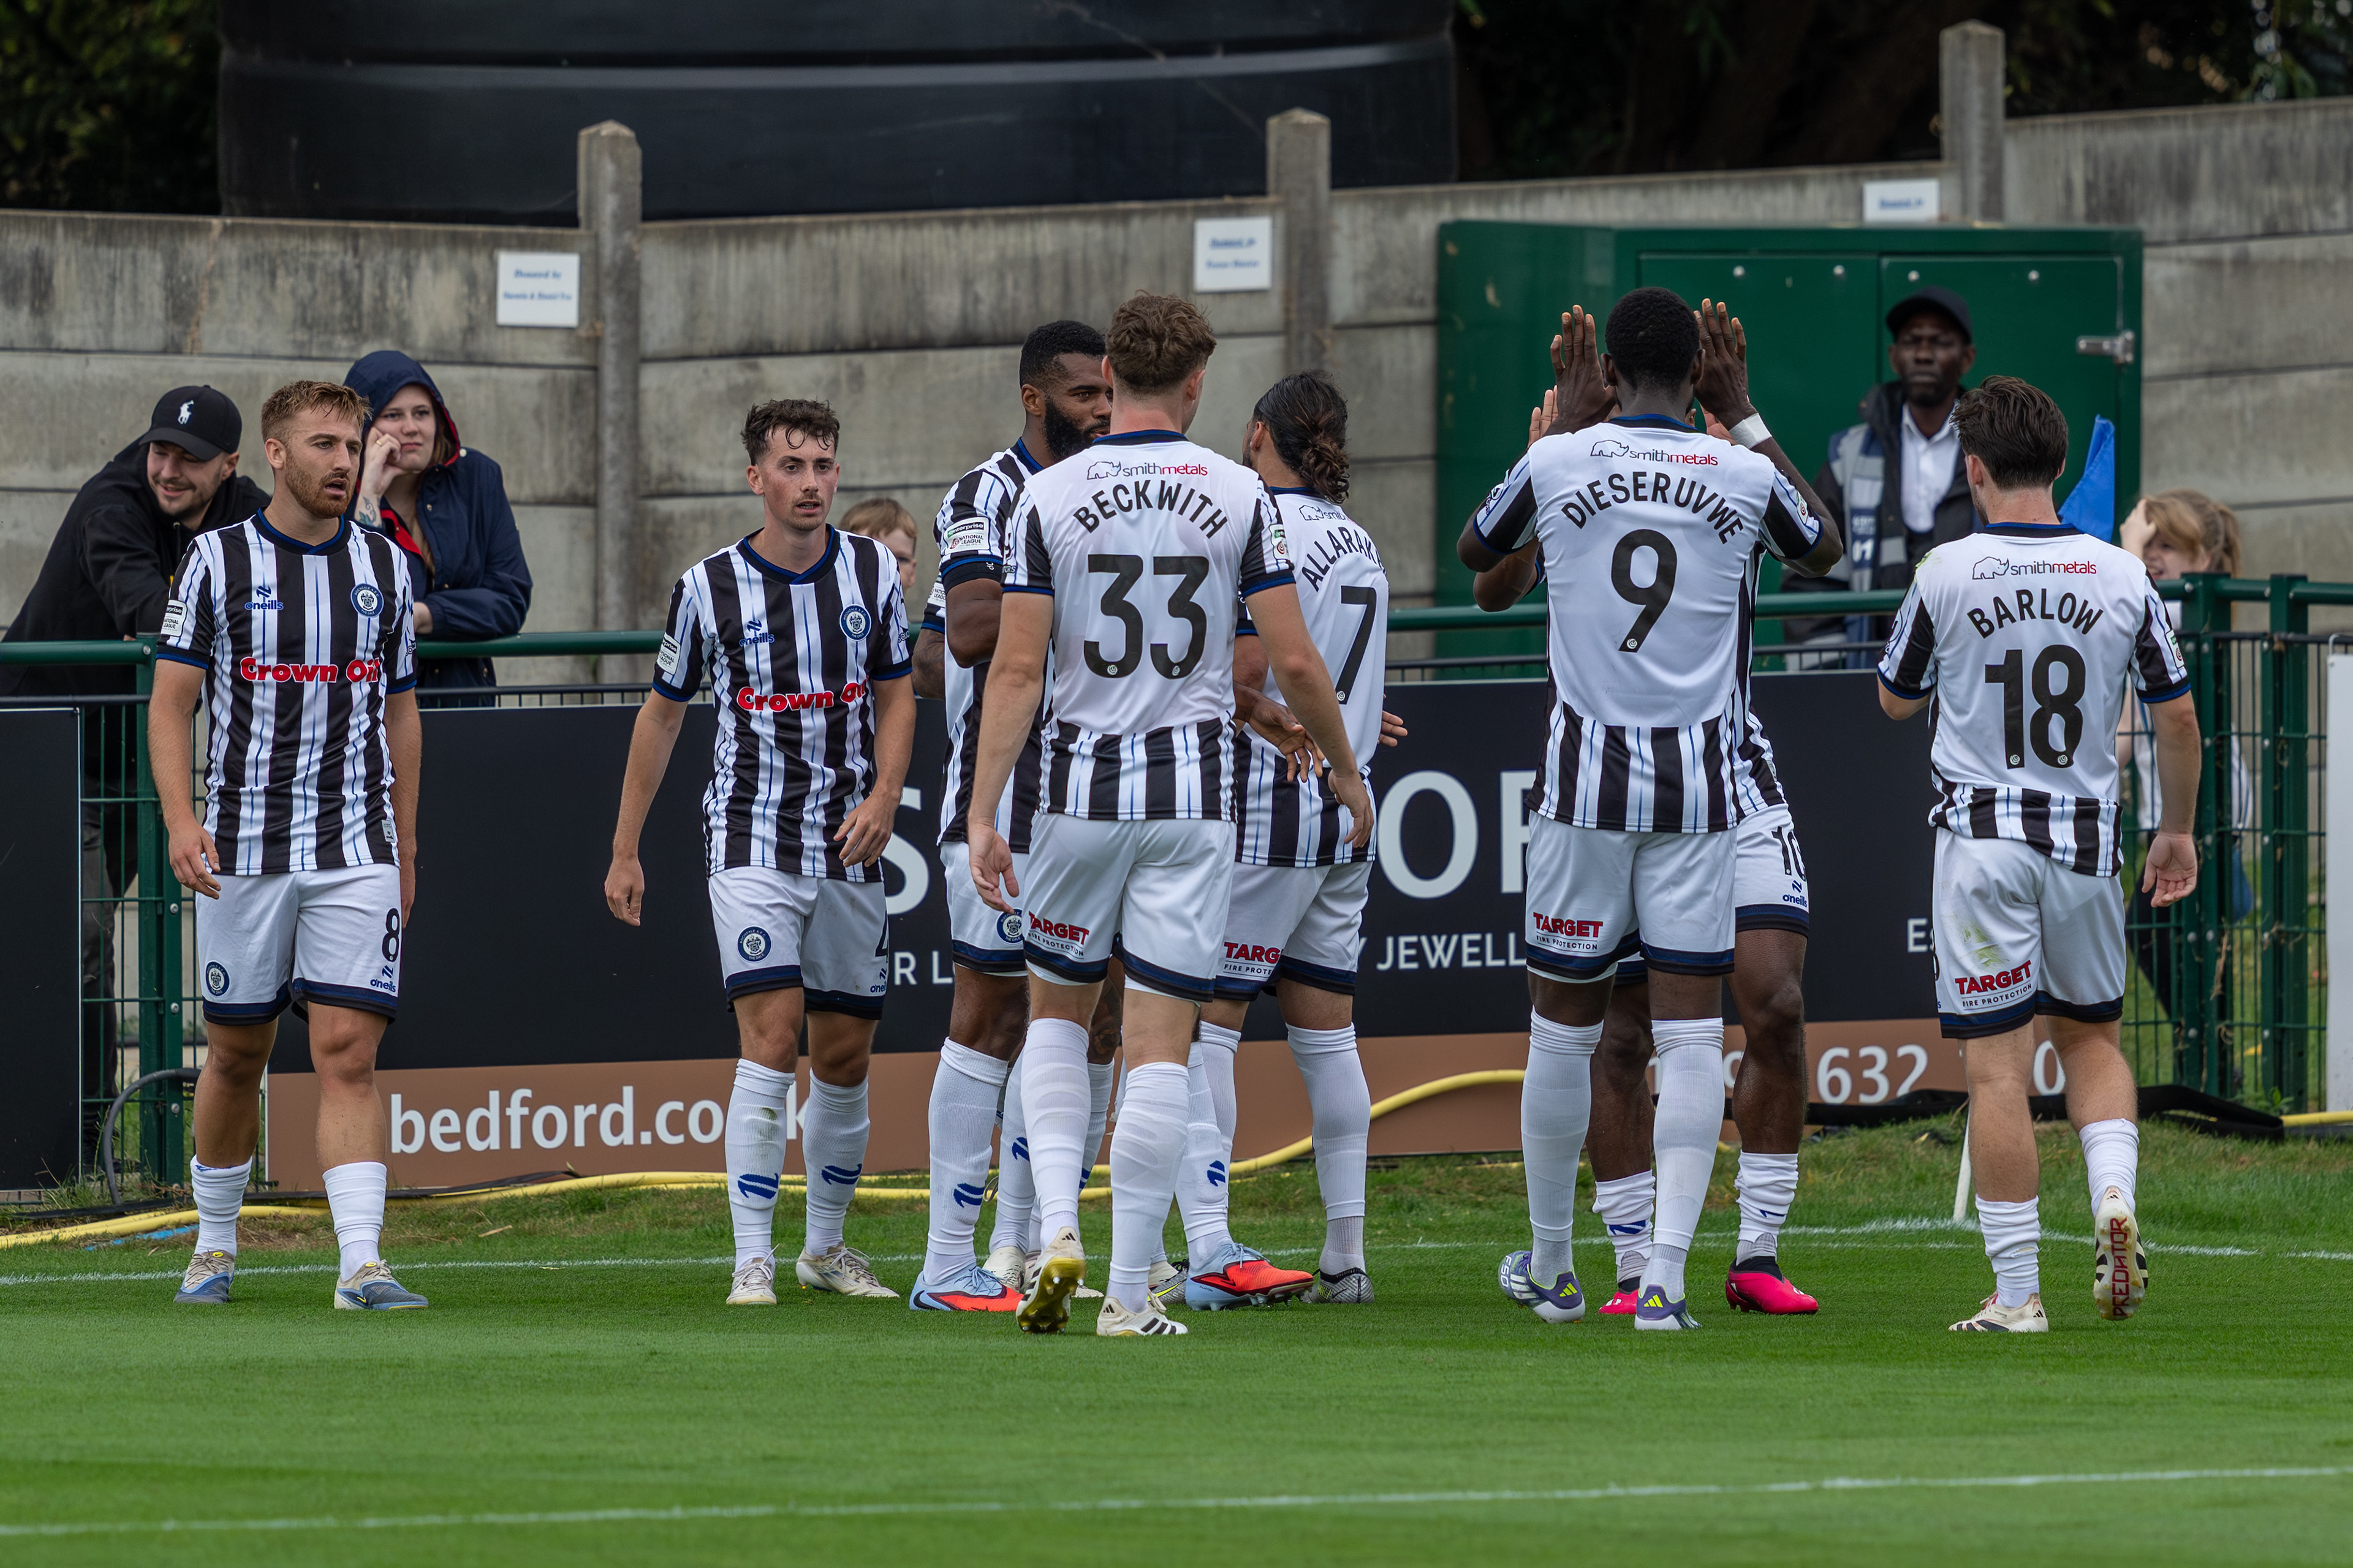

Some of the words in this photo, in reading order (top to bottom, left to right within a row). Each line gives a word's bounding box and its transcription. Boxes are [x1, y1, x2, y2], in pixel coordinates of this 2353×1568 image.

[1123, 463, 1208, 477] smithmetals
[1629, 449, 1719, 466] smithmetals
[1073, 480, 1228, 539] BECKWITH
[1324, 510, 1349, 520] smith
[1561, 471, 1745, 545] DIESERUVWE
[1302, 526, 1387, 593] ALLARAK
[2010, 560, 2097, 575] smithmetals
[1611, 529, 1678, 653] 9
[1084, 554, 1210, 679] 33
[1967, 588, 2104, 639] BARLOW
[1335, 585, 1377, 705] 7
[240, 656, 338, 683] Crown
[346, 657, 380, 683] Oil
[737, 686, 834, 713] Crown
[1985, 644, 2086, 770] 18
[382, 907, 400, 963] 8
[1028, 911, 1089, 945] TARGET
[1533, 912, 1604, 938] TARGET
[1042, 939, 1083, 956] PROTECTION
[1224, 941, 1284, 964] TARG
[1376, 932, 1526, 971] JEWELL
[1536, 935, 1550, 944] FIRE
[1552, 938, 1597, 950] PROTECTION
[1246, 966, 1272, 975] PROTE
[1955, 960, 2031, 995] TARGET
[1982, 983, 2032, 1005] PROTECTION
[1816, 1044, 1929, 1104] 632
[1500, 1255, 1512, 1287] F50
[2110, 1216, 2129, 1317] PREDATOR
